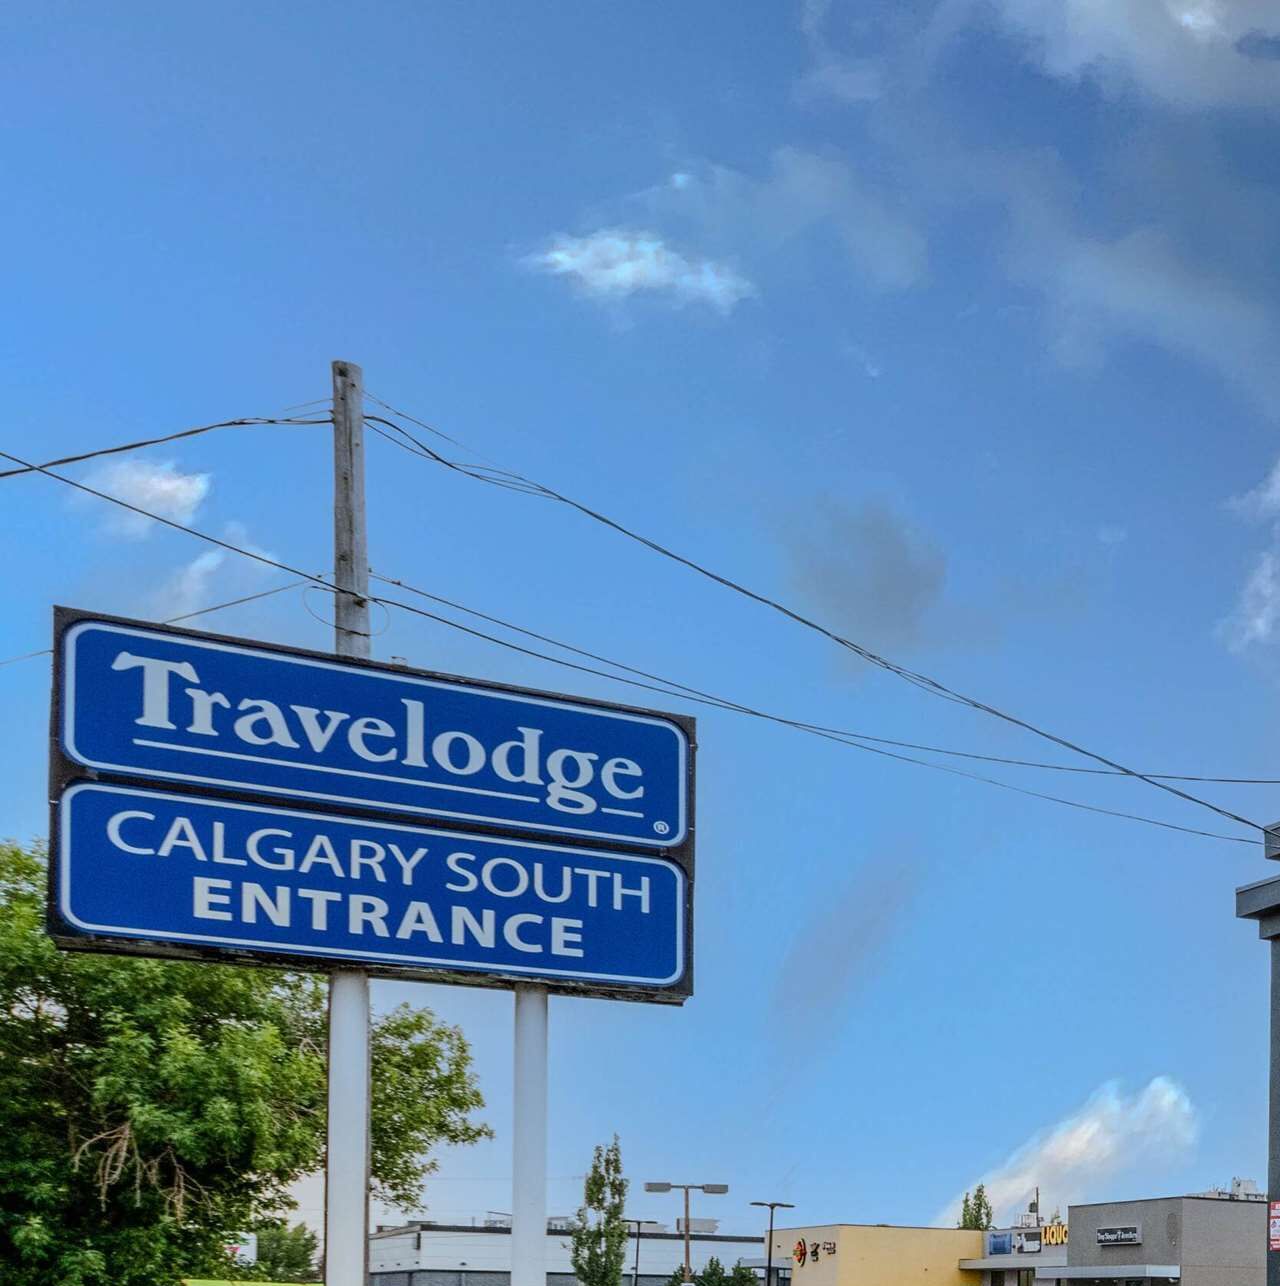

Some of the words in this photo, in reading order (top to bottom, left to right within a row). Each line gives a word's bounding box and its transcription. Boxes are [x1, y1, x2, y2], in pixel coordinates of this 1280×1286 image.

[112, 651, 644, 815] Travelodge
[107, 810, 428, 886] CALGARY
[446, 852, 650, 914] SOUTH
[193, 876, 585, 958] ENTRANCE
[1041, 1225, 1068, 1245] LIQUO
